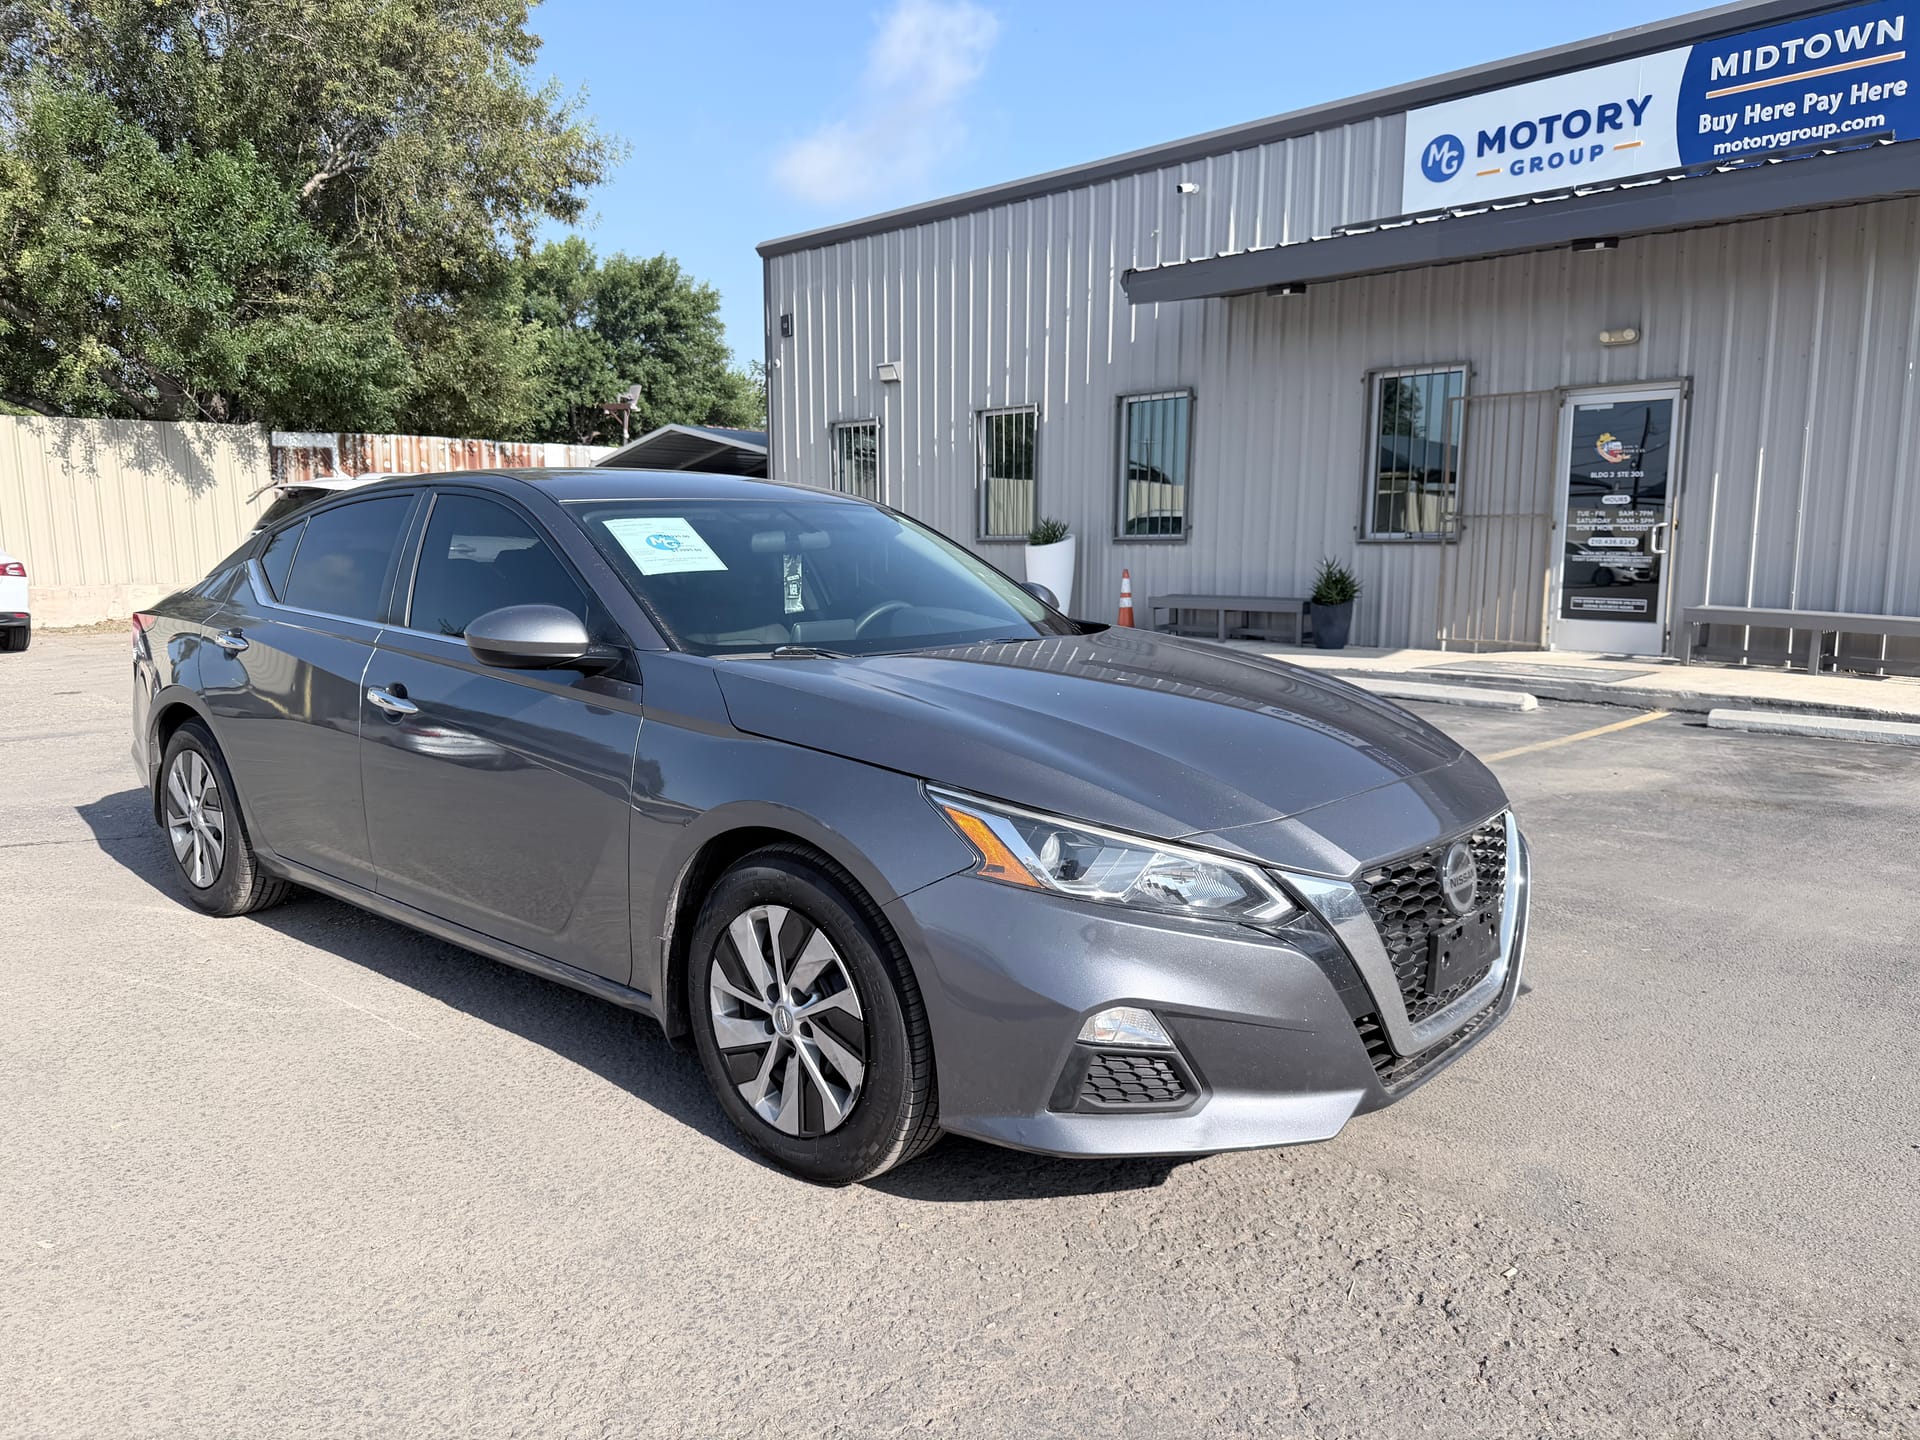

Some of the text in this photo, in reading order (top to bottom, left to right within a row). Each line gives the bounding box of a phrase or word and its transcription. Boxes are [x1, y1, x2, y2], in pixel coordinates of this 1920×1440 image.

[1710, 15, 1905, 81] MIDTOWN
[1477, 94, 1653, 158] MOTORY
[1698, 79, 1908, 135] Buy Here Pay Here
[1713, 113, 1885, 156] motorygroup.com
[1427, 140, 1459, 175] MG
[1510, 144, 1604, 176] GROUP
[1450, 868, 1474, 889] NISSAN
